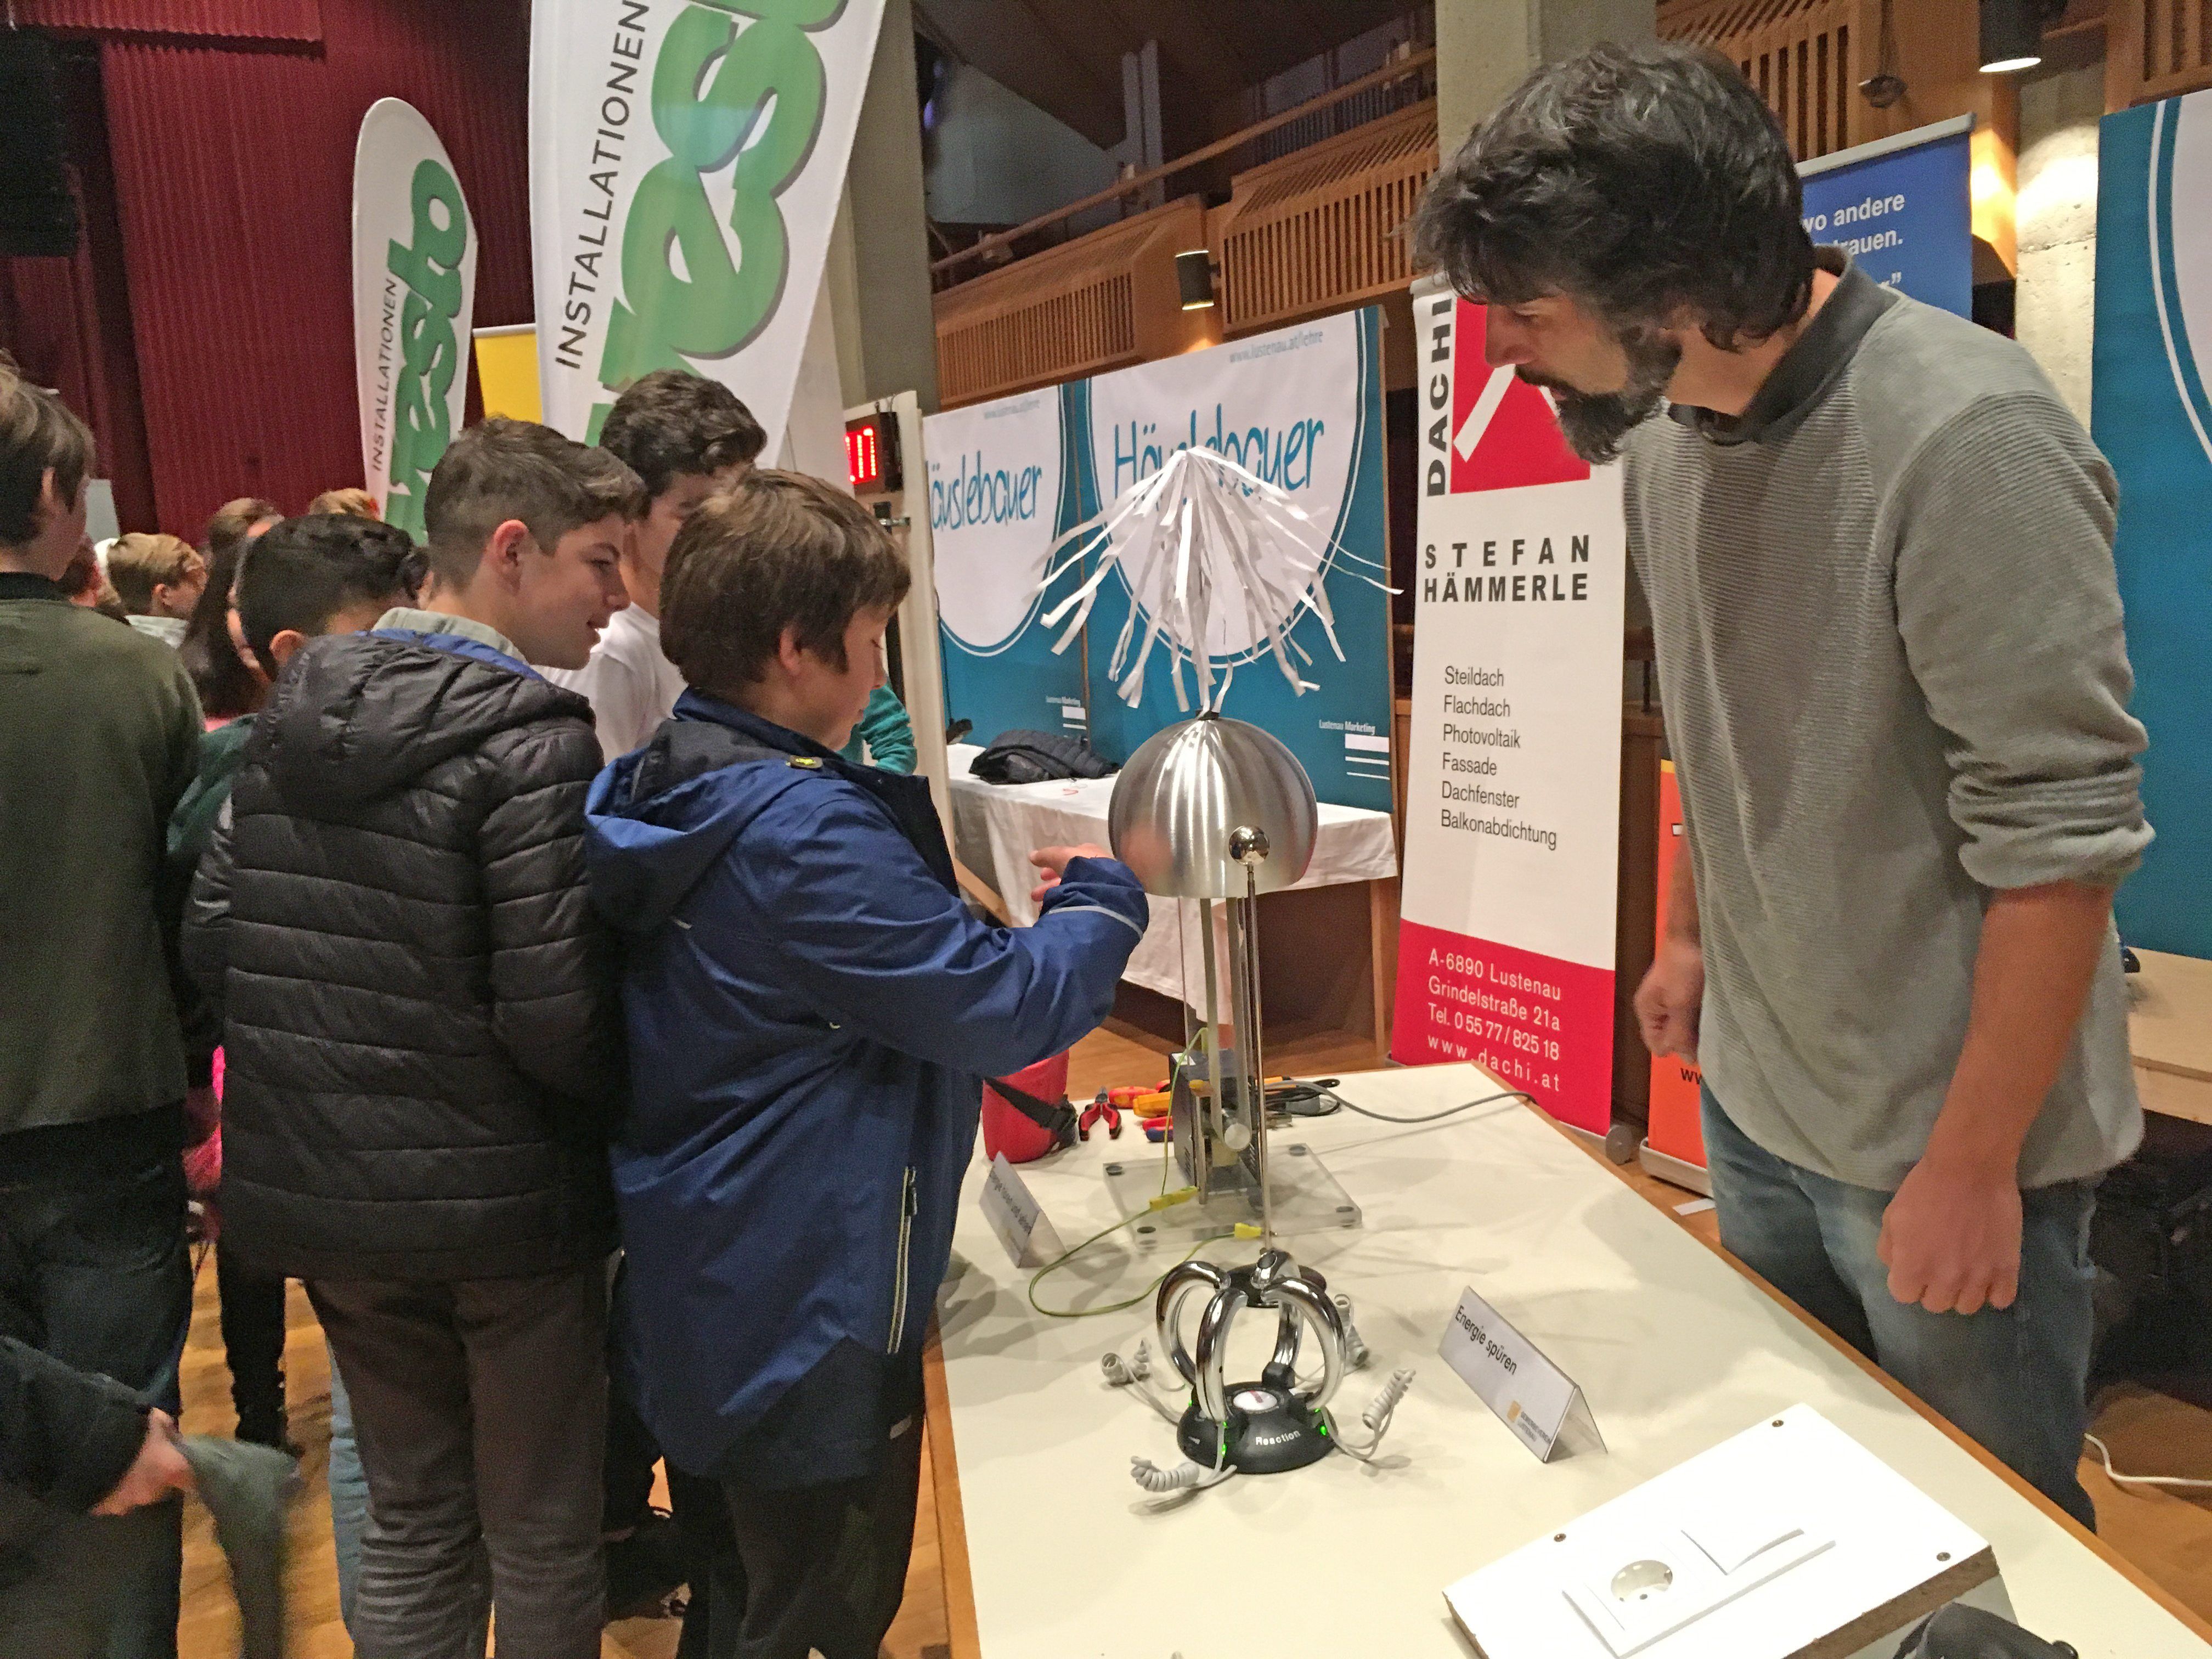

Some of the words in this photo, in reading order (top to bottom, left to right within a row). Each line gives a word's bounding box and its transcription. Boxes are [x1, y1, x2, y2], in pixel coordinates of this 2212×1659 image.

[556, 0, 650, 369] INSTALLATIONEN
[1833, 194, 1905, 226] andere
[1833, 230, 1903, 255] auen.
[373, 279, 397, 471] INSTALLATIONEN
[1427, 299, 1452, 496] DACHI
[926, 450, 1042, 532] äuslebauer
[1425, 535, 1589, 569] STEFAN
[1424, 572, 1587, 602] HÄMMERLE
[1444, 665, 1504, 686] Steildach
[1444, 695, 1510, 716] Flachdach
[1443, 724, 1521, 748] Photovoltaik
[1443, 752, 1497, 776] Fassade
[1442, 781, 1520, 808] Dachfenster
[1441, 809, 1556, 851] Balkonabdichtung
[1429, 948, 1483, 978] A-6890
[1490, 963, 1561, 1001] Lustenau
[1428, 1002, 1451, 1025] Tel.
[1429, 975, 1527, 1020] Grindelstraße
[1533, 1006, 1560, 1031] 21a
[1455, 1305, 1486, 1345] Energie
[1486, 1340, 1517, 1375] spüren
[1256, 1430, 1301, 1446] Reaction
